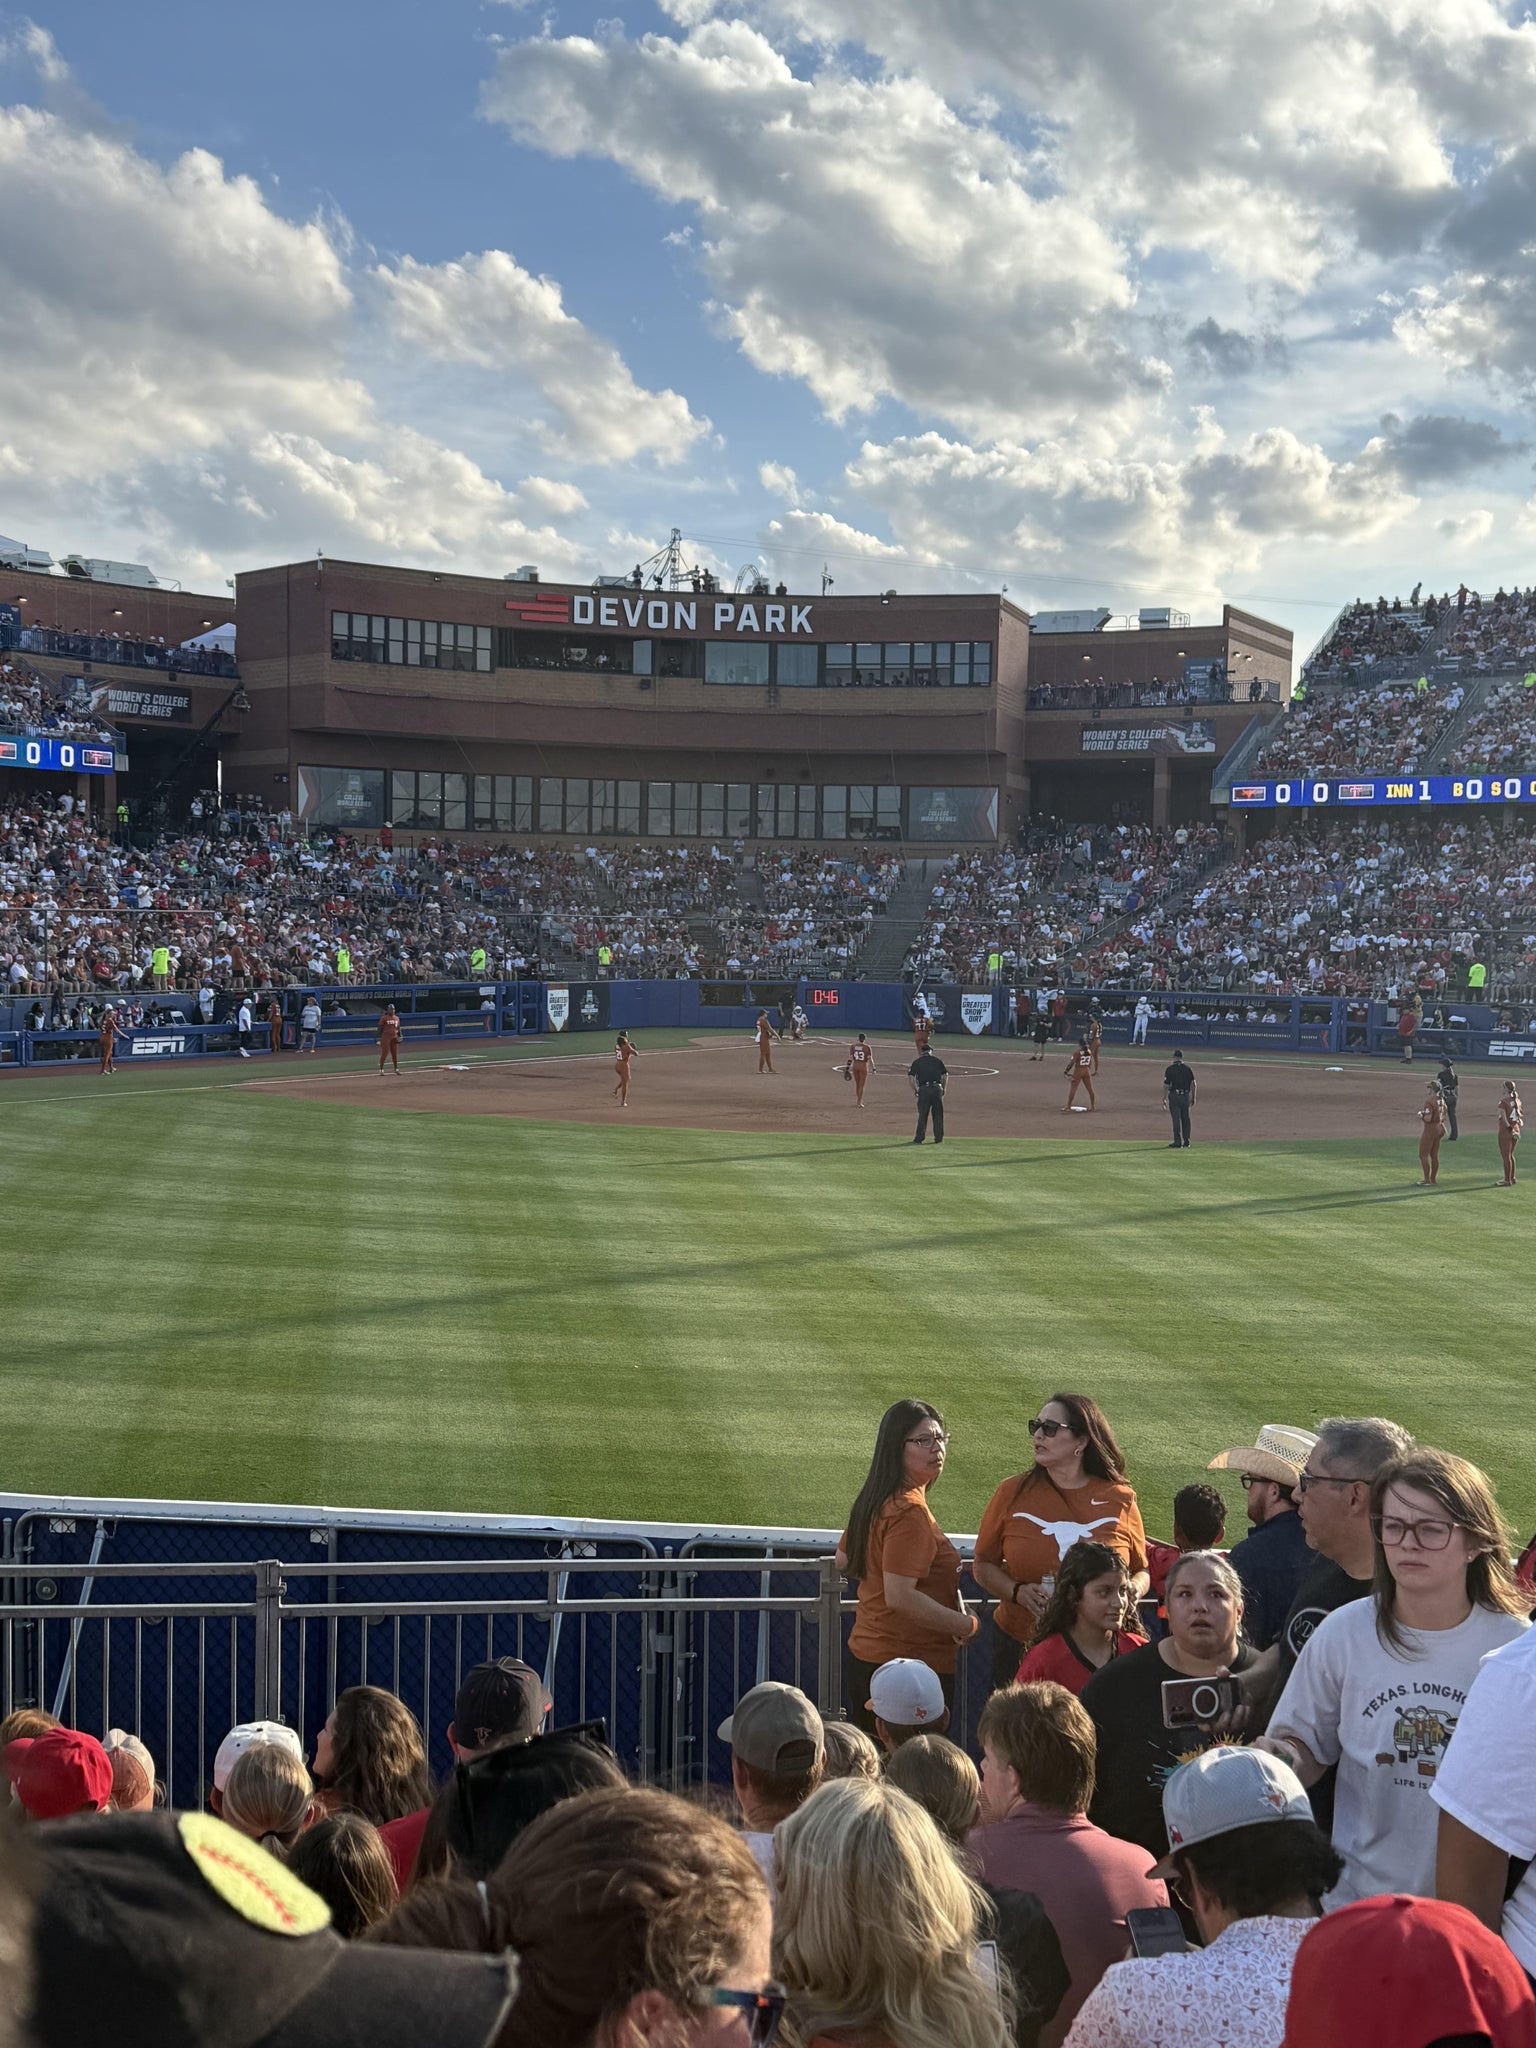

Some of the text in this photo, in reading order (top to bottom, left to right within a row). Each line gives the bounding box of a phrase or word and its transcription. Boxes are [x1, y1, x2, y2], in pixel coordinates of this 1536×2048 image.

[573, 595, 814, 634] DEVON PARK
[108, 689, 151, 704] WOMEN'S
[152, 694, 189, 708] COLLEGE
[108, 700, 173, 717] WORLD SERIES
[1082, 728, 1168, 741] WOMEN'S COLLEGE
[1082, 739, 1150, 751] WORLD SERIES
[26, 742, 40, 765] 0
[60, 745, 75, 767] 0
[1275, 784, 1291, 804] 0
[1313, 783, 1329, 803] 0
[1385, 783, 1414, 799] INN
[1418, 780, 1432, 801] 1
[962, 1001, 991, 1009] GREATEST
[964, 1008, 982, 1016] SHOW
[968, 1015, 983, 1023] DIRT
[131, 1035, 186, 1055] ESPN
[1488, 1040, 1536, 1057] ESP
[853, 1051, 865, 1061] 43
[1079, 1055, 1091, 1066] 23
[1362, 1685, 1407, 1718] TEXAS
[1418, 1781, 1428, 1790] IS
